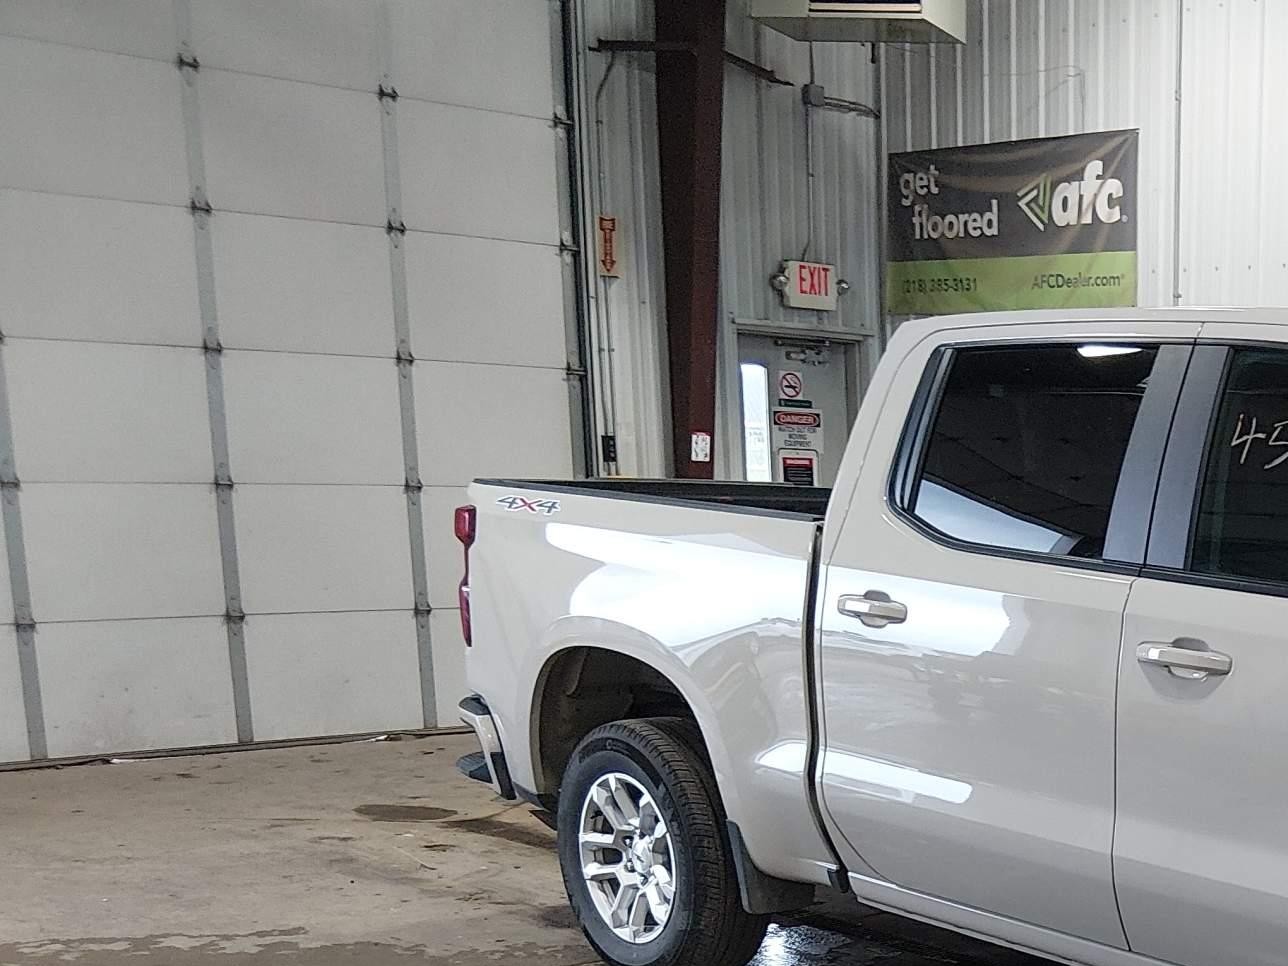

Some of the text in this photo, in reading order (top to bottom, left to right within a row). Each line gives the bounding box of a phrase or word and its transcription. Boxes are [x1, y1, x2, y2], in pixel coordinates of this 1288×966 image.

[900, 165, 939, 206] get
[912, 199, 999, 239] floored
[799, 265, 830, 297] EXIT
[780, 414, 815, 424] DANGER
